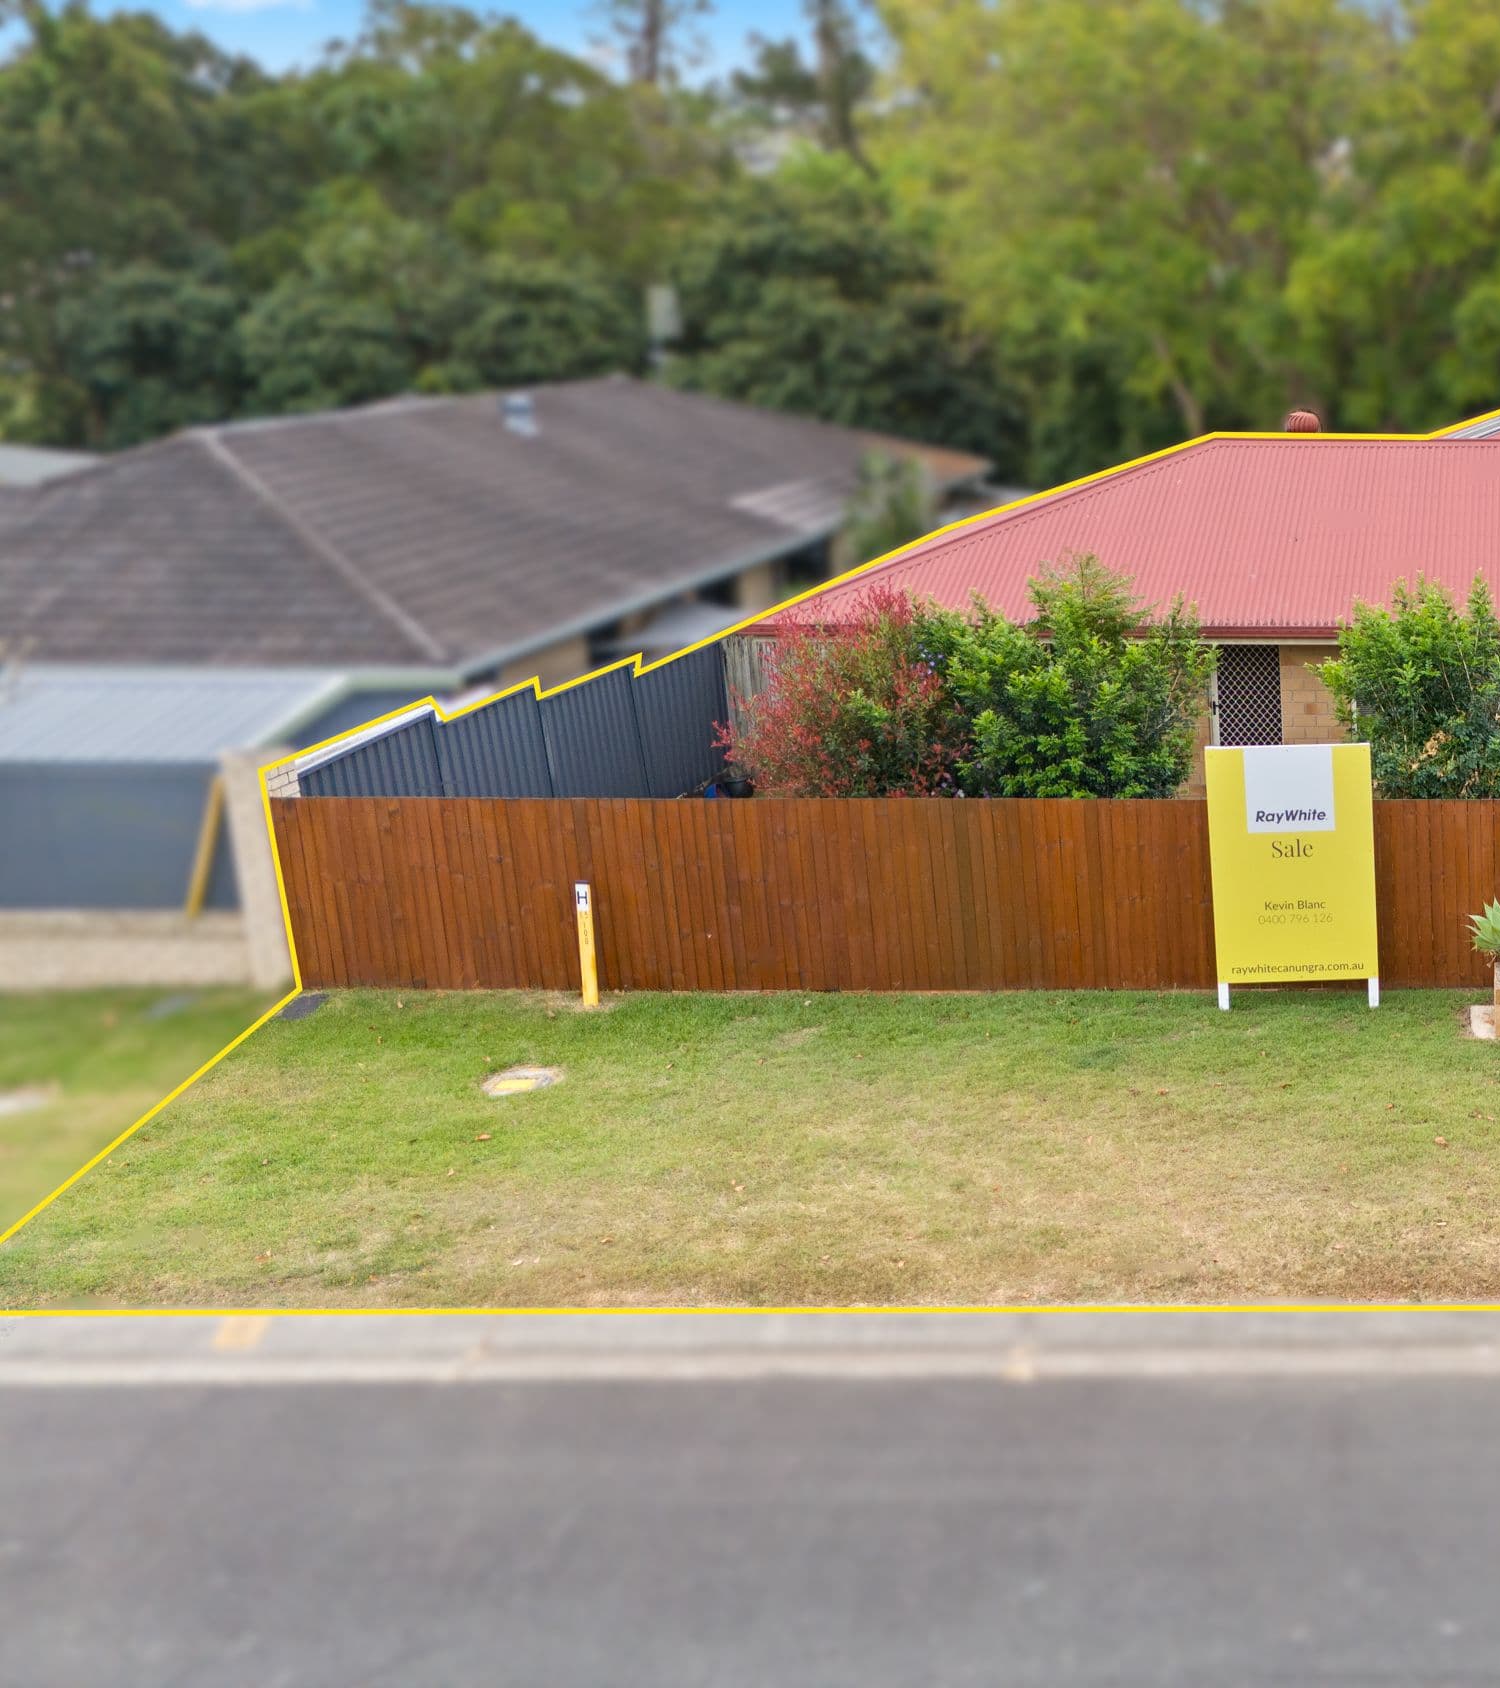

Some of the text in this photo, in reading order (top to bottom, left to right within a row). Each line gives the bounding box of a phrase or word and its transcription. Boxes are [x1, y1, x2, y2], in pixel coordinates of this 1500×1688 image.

[1271, 839, 1313, 858] Sale
[577, 891, 587, 904] H
[1264, 900, 1327, 911] Kevin Blanc
[1257, 914, 1287, 925] 0400
[1314, 912, 1333, 922] 126
[1231, 962, 1364, 975] raywhitecanungra.com.au
